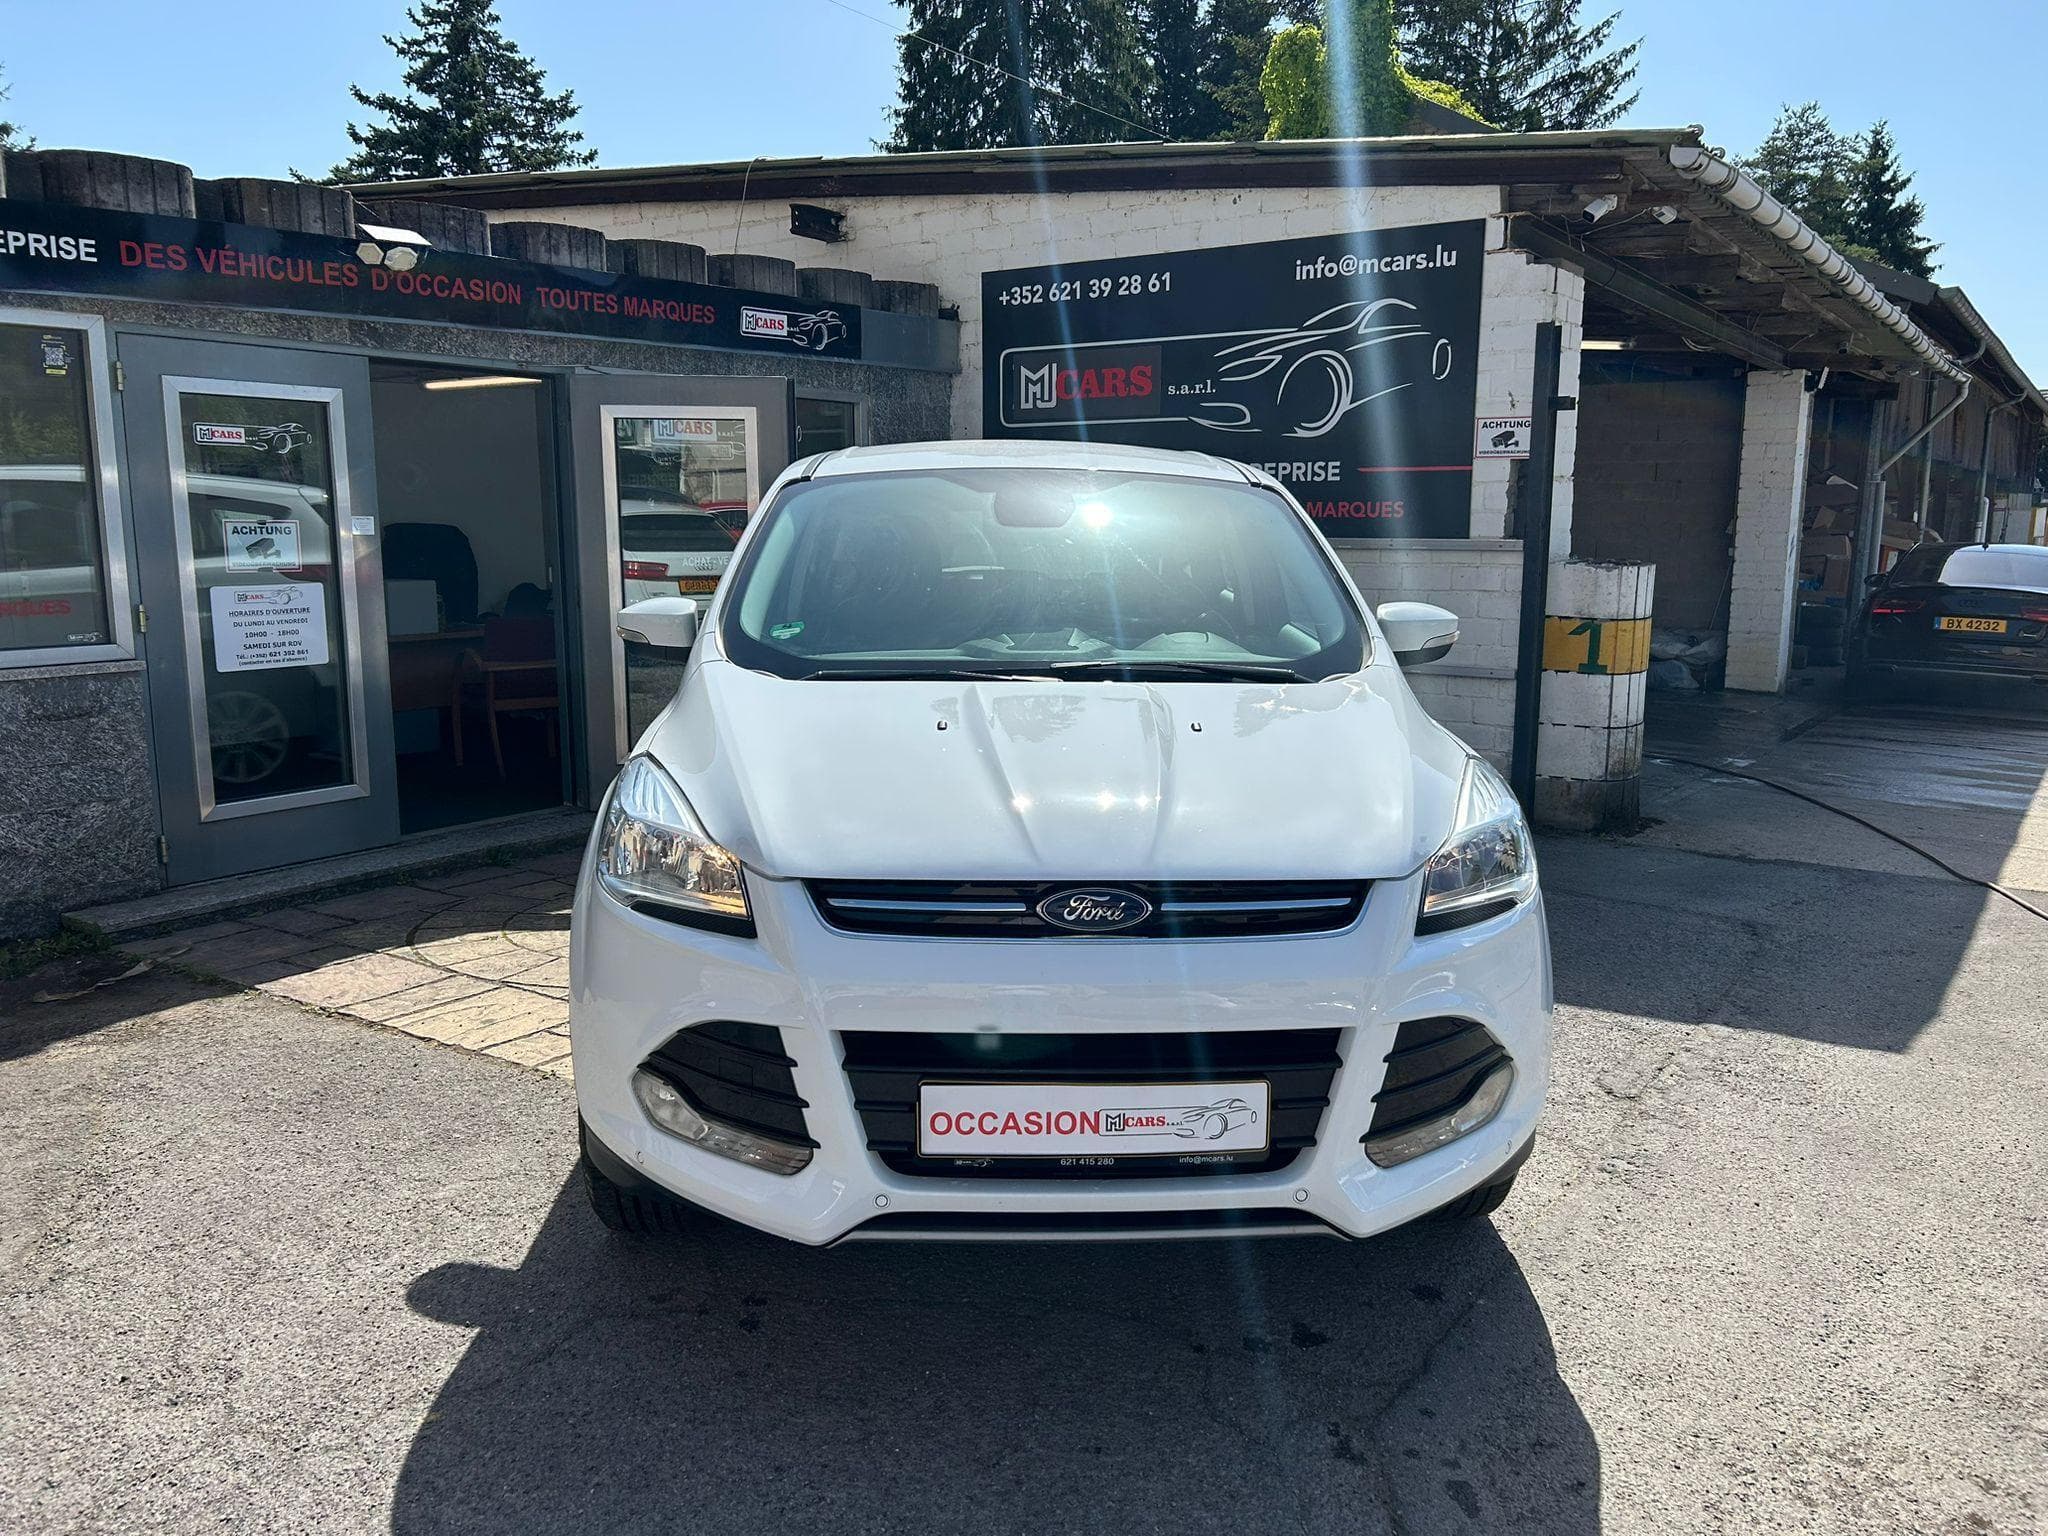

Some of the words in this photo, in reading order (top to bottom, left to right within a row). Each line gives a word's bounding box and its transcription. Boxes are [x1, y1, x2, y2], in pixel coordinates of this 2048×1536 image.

[1295, 244, 1458, 281] info@mcars.lu
[119, 240, 187, 271] DES
[195, 245, 358, 287] VÉHICULES
[371, 267, 521, 305] D'OCCASION
[536, 287, 617, 314] TOUTES
[624, 296, 716, 324] MARQUES
[998, 284, 1043, 306] +352
[1049, 280, 1081, 302] 621
[1088, 277, 1112, 298] 39
[1117, 274, 1142, 296] 28
[1148, 271, 1171, 293] 61
[1168, 380, 1217, 396] s.a.r.l.
[1481, 420, 1531, 429] ACHTUNG
[1306, 501, 1404, 518] MARQUES
[231, 525, 292, 536] ACHTUNG
[228, 608, 264, 617] HORAIRES
[265, 606, 311, 616] D'OUVERTURE
[277, 617, 309, 625] VENDREDI
[1946, 618, 1963, 630] BX
[1965, 619, 2001, 632] 4232
[243, 642, 271, 650] SAMEDI
[1568, 622, 1608, 673] 1
[1064, 894, 1126, 920] Ford
[929, 1111, 1100, 1136] OCCASION
[1179, 1155, 1234, 1164] info@mcars.lu
